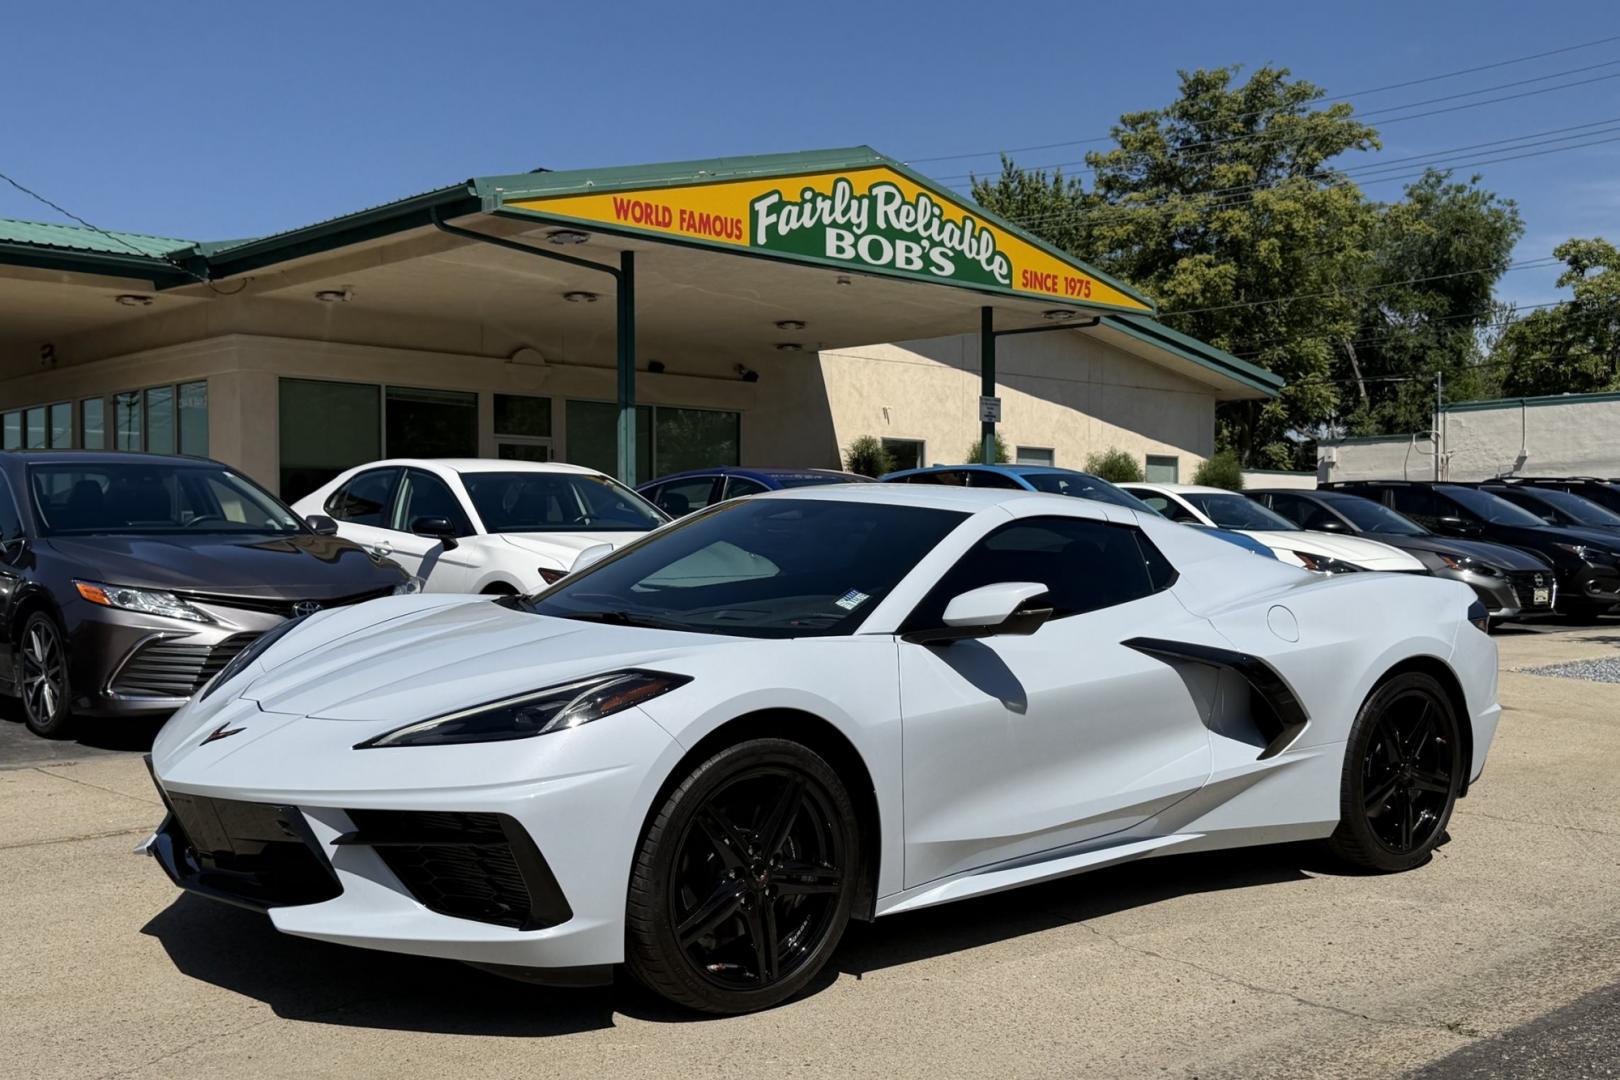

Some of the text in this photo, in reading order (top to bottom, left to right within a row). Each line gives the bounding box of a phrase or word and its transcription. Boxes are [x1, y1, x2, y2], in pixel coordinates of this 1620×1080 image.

[613, 197, 743, 240] WORLD FAMOUS
[754, 181, 1010, 284] Fairly Reliable
[825, 227, 956, 277] BOB'S
[1022, 269, 1091, 298] SINCE 1975
